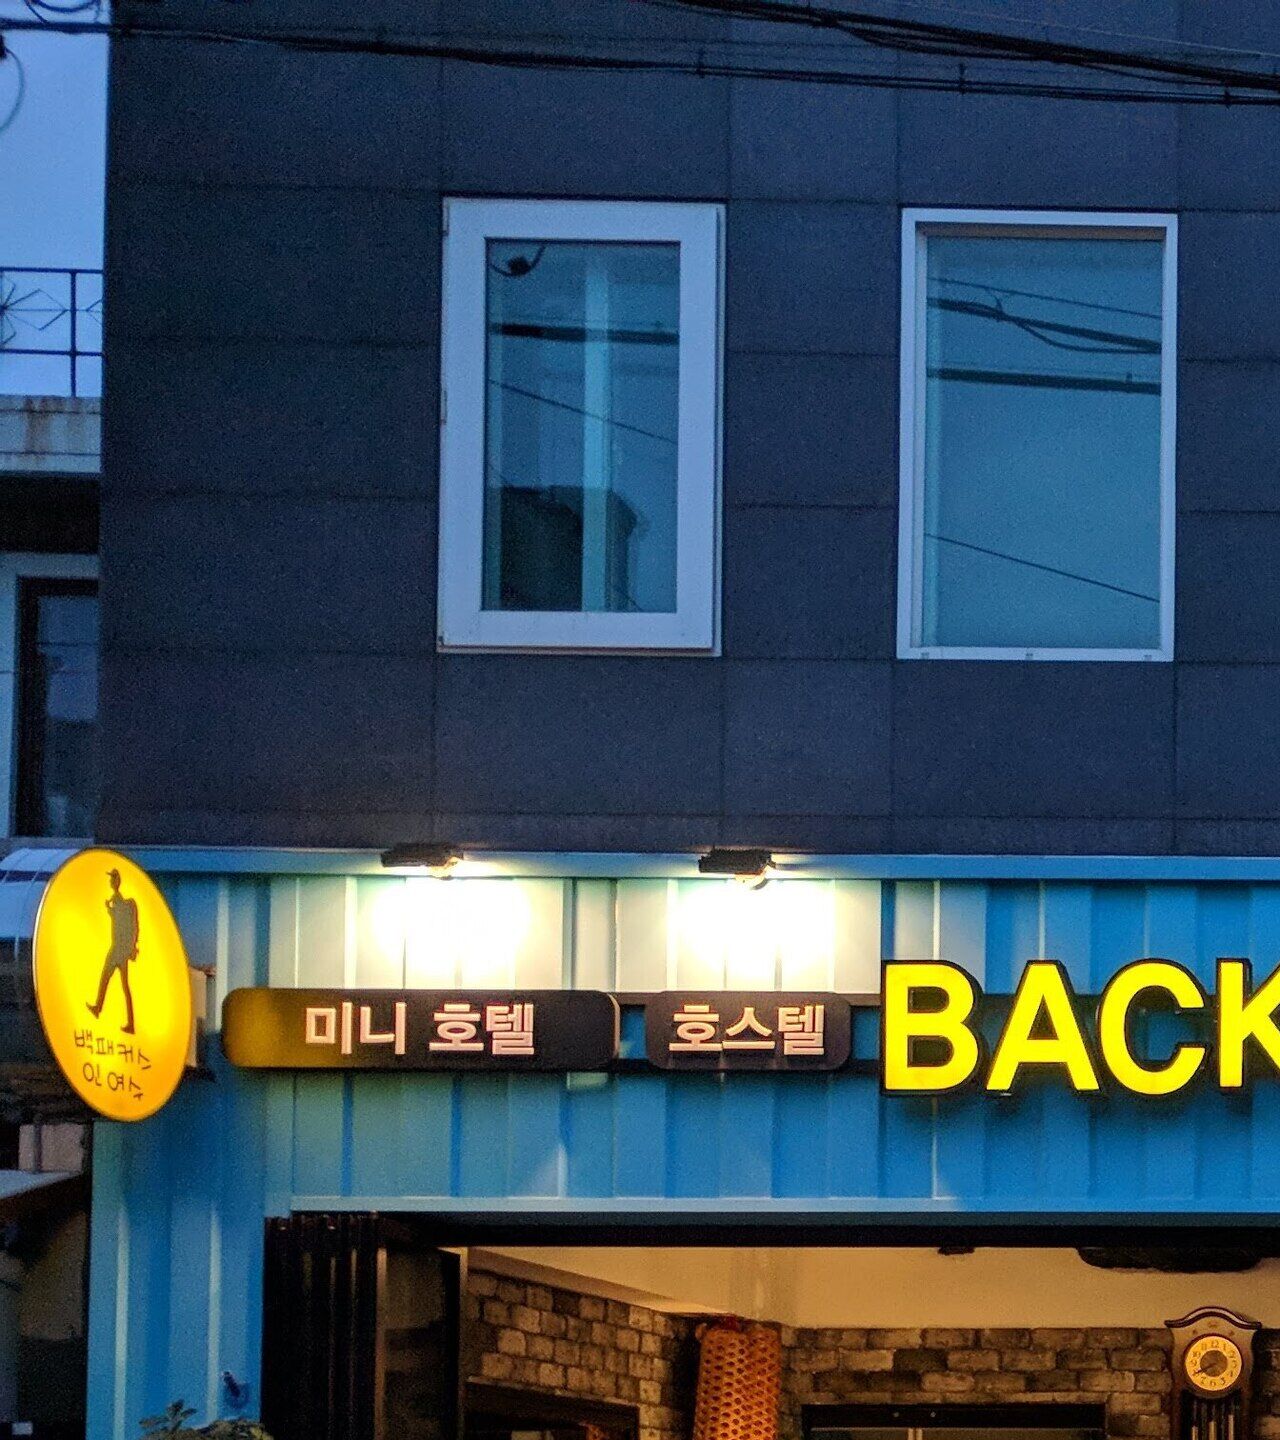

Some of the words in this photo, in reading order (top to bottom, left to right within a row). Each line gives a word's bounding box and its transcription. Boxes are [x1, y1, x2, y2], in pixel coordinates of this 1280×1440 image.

[74, 1029, 151, 1070] 백패커스
[305, 1002, 406, 1054] 미니
[429, 1002, 536, 1055] 호텔
[668, 1003, 825, 1056] 호스텔
